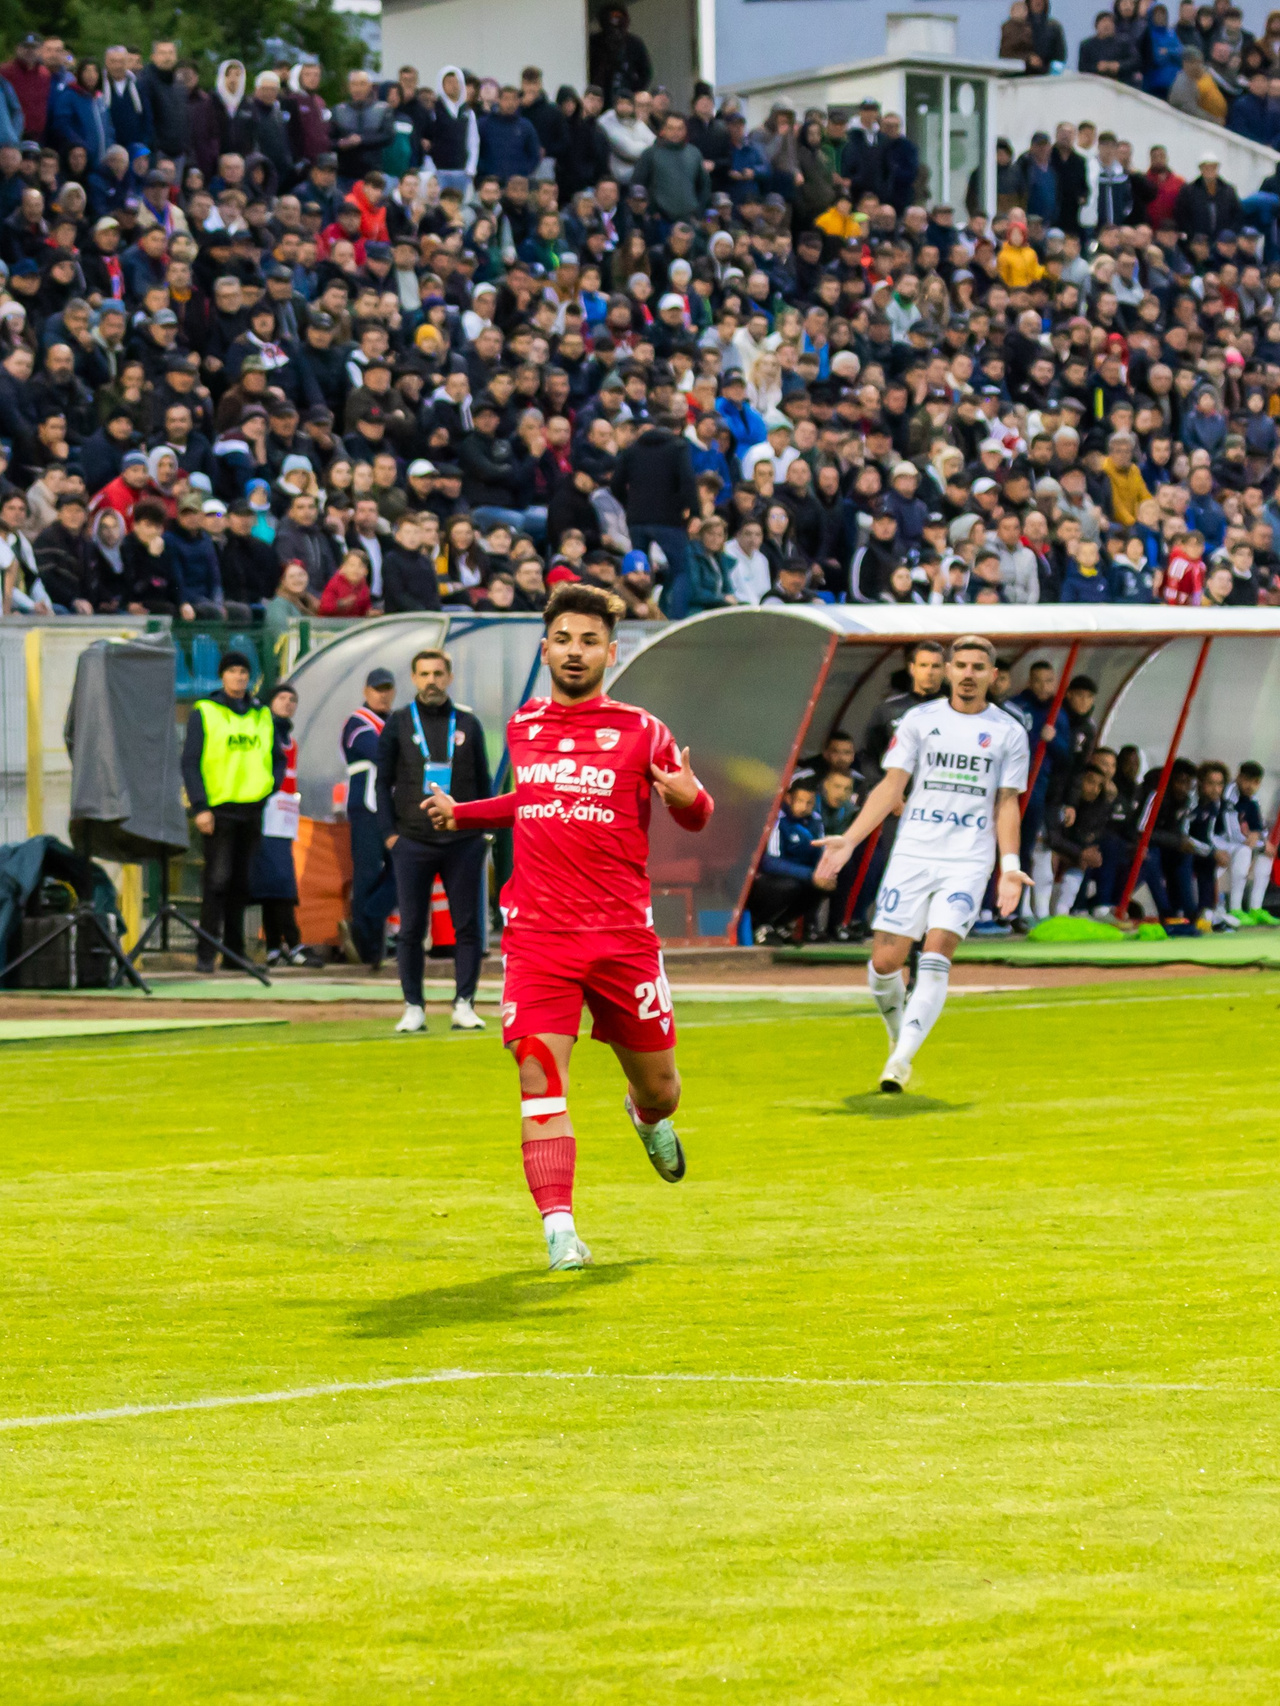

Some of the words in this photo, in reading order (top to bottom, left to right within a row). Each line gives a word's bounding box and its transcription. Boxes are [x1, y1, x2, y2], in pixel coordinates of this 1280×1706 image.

[516, 758, 616, 789] WIN2.RO
[926, 752, 993, 774] UNIBET
[910, 808, 988, 830] ELSACO
[634, 975, 672, 1020] 20
